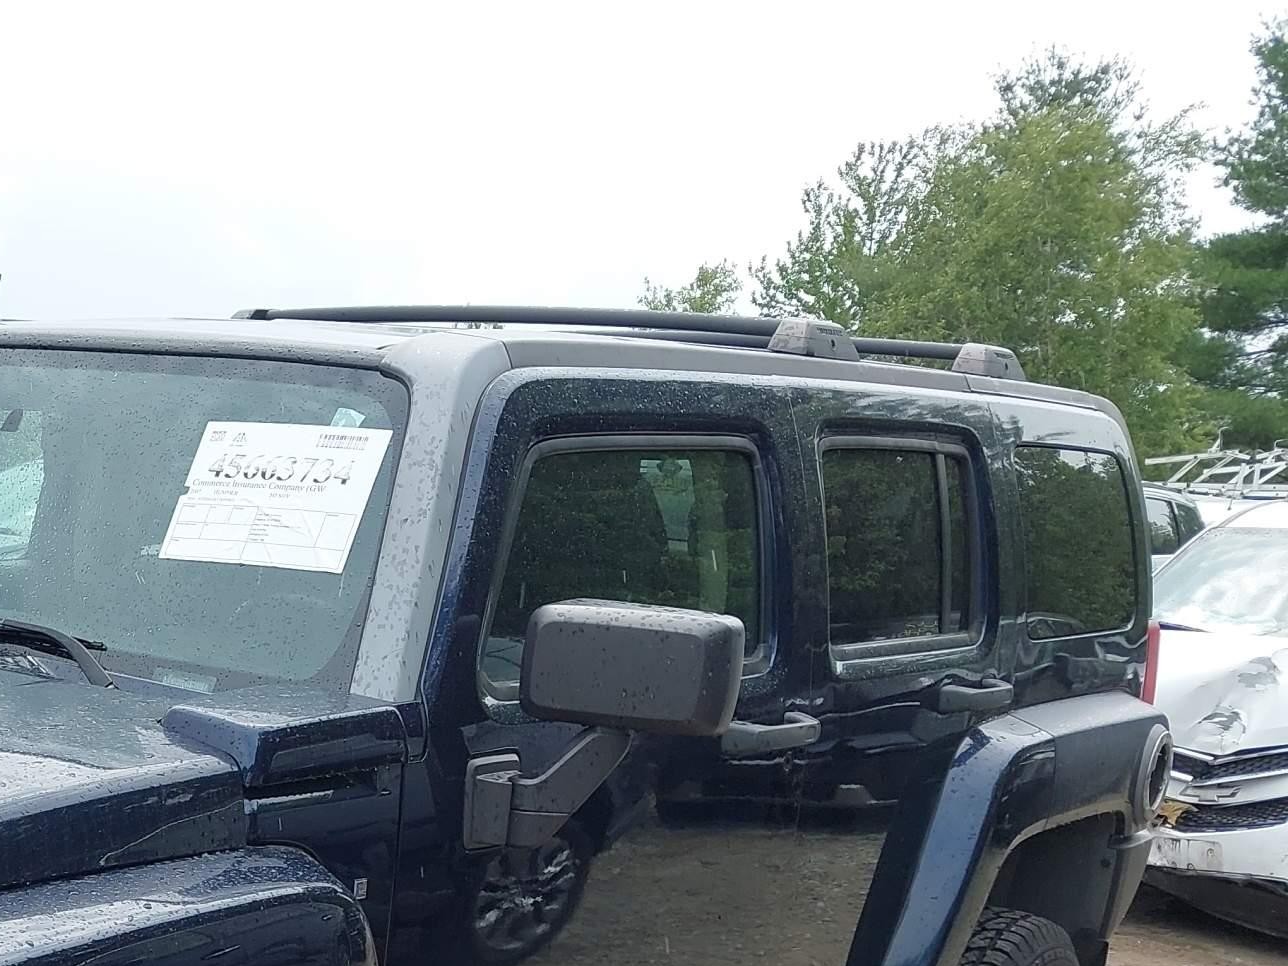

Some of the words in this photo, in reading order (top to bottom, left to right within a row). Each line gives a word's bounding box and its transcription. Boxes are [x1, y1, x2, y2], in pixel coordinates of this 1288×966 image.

[192, 478, 231, 488] Commerce
[232, 480, 267, 489] Insurance
[268, 482, 305, 493] Company
